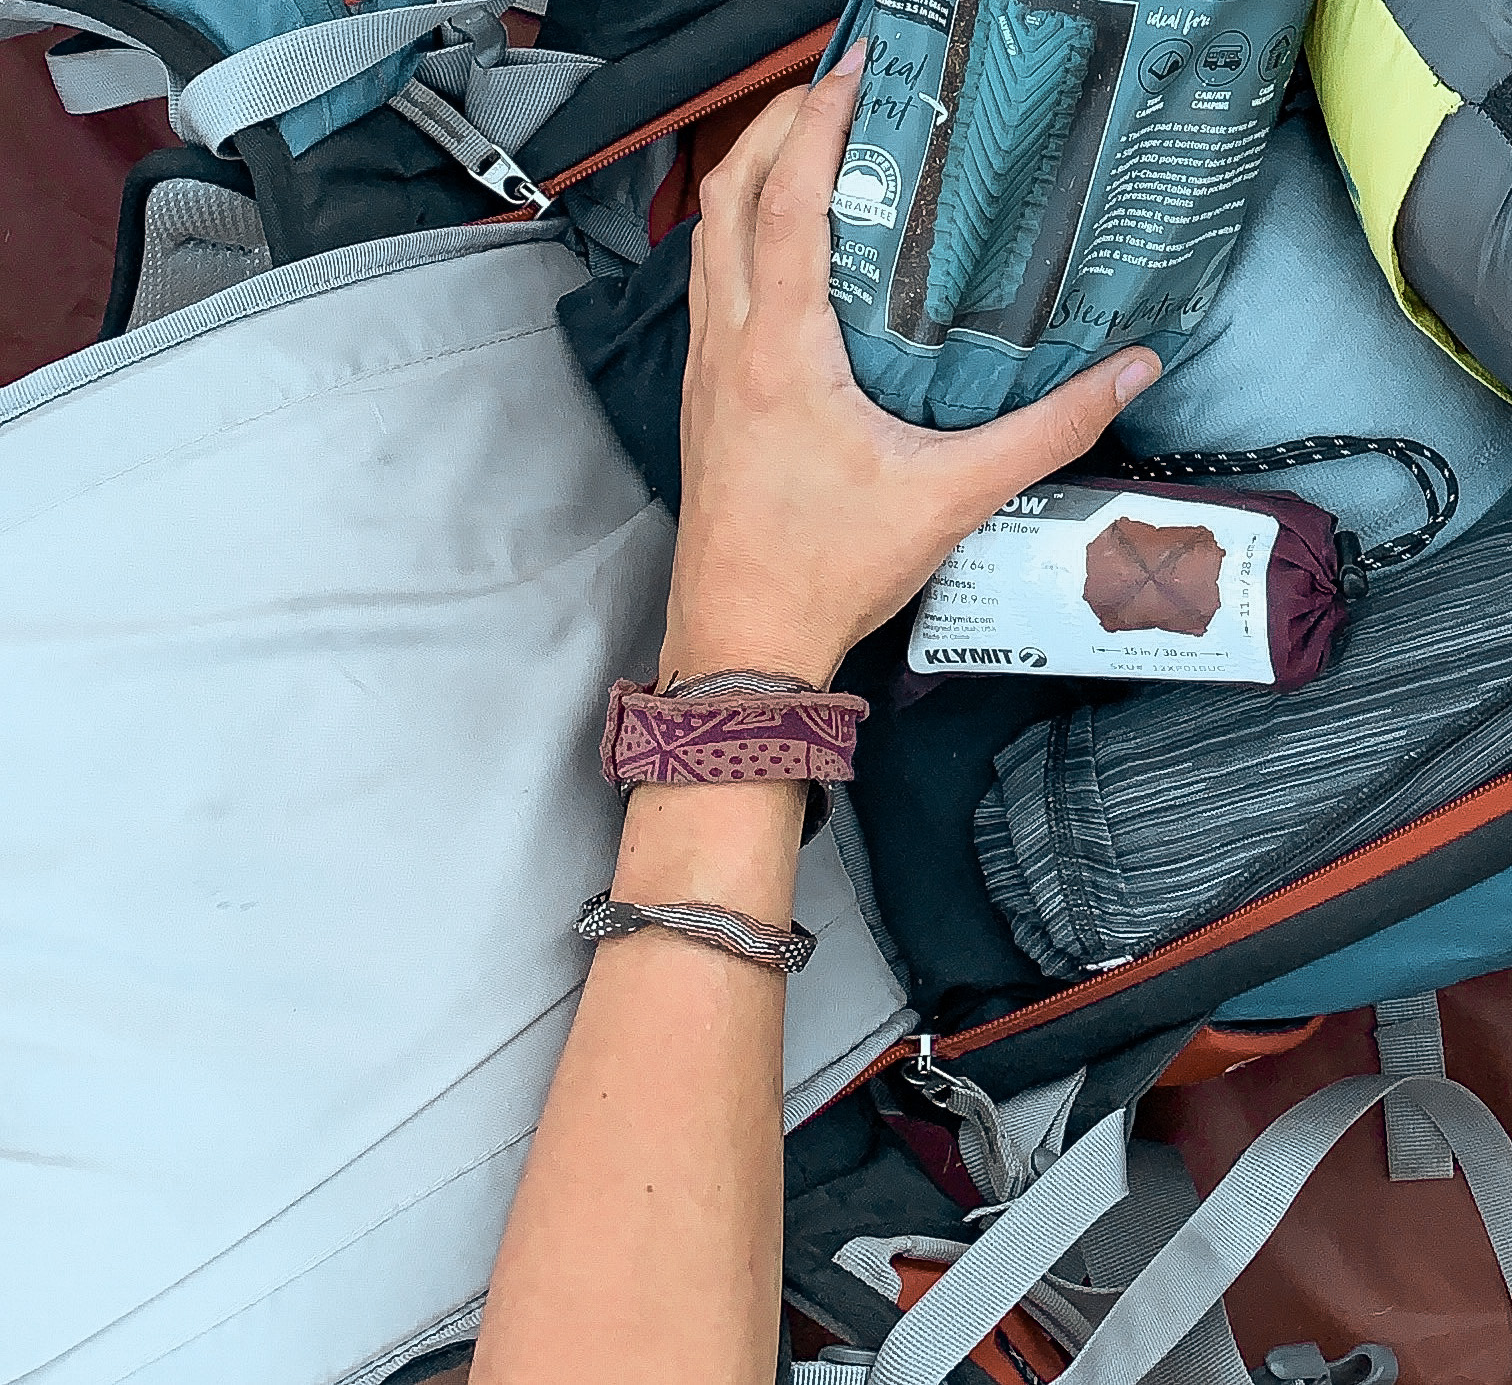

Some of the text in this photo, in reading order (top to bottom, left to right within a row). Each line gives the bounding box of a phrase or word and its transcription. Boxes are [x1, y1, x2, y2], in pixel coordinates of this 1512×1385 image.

[1146, 6, 1183, 29] ideal
[862, 34, 929, 91] Real
[853, 82, 919, 131] fort
[1191, 101, 1230, 111] CAMPING
[1154, 122, 1173, 132] pad
[1173, 122, 1183, 132] in
[1183, 123, 1200, 133] the
[1200, 124, 1227, 134] Static
[1162, 139, 1174, 148] at
[1174, 139, 1210, 150] bottom
[1210, 141, 1222, 152] of
[1158, 155, 1204, 168] polyester
[864, 150, 898, 202] LIFETIME
[1131, 169, 1187, 183] V-Chambers
[1133, 181, 1192, 197] comfortable
[1192, 185, 1208, 196] loft
[1121, 192, 1194, 208] pressure points
[831, 195, 893, 222] ARANTEE
[1126, 208, 1154, 219] make
[1153, 210, 1163, 222] it
[1163, 214, 1192, 225] easier
[1119, 217, 1137, 228] the
[1136, 220, 1165, 235] night
[1114, 233, 1124, 243] is
[1125, 234, 1146, 248] fast
[1145, 241, 1166, 252] and
[1098, 248, 1112, 259] kit
[1112, 249, 1121, 260] &
[1121, 253, 1148, 267] stuff
[1147, 259, 1168, 269] sack
[859, 259, 881, 284] USA
[1051, 288, 1124, 340] Sleep
[1000, 522, 1040, 535] Pillow
[947, 560, 959, 569] oz
[969, 560, 985, 571] 64
[987, 563, 995, 574] g
[1240, 560, 1252, 576] 28
[932, 573, 976, 590] hickness:
[951, 592, 958, 605] /
[960, 593, 978, 604] 8.9
[980, 597, 999, 606] cm
[1240, 601, 1250, 617] 11
[924, 613, 995, 625] www.klymit.com
[924, 648, 1013, 665] KLYMIT
[1123, 647, 1138, 656] 15
[1139, 647, 1151, 656] in
